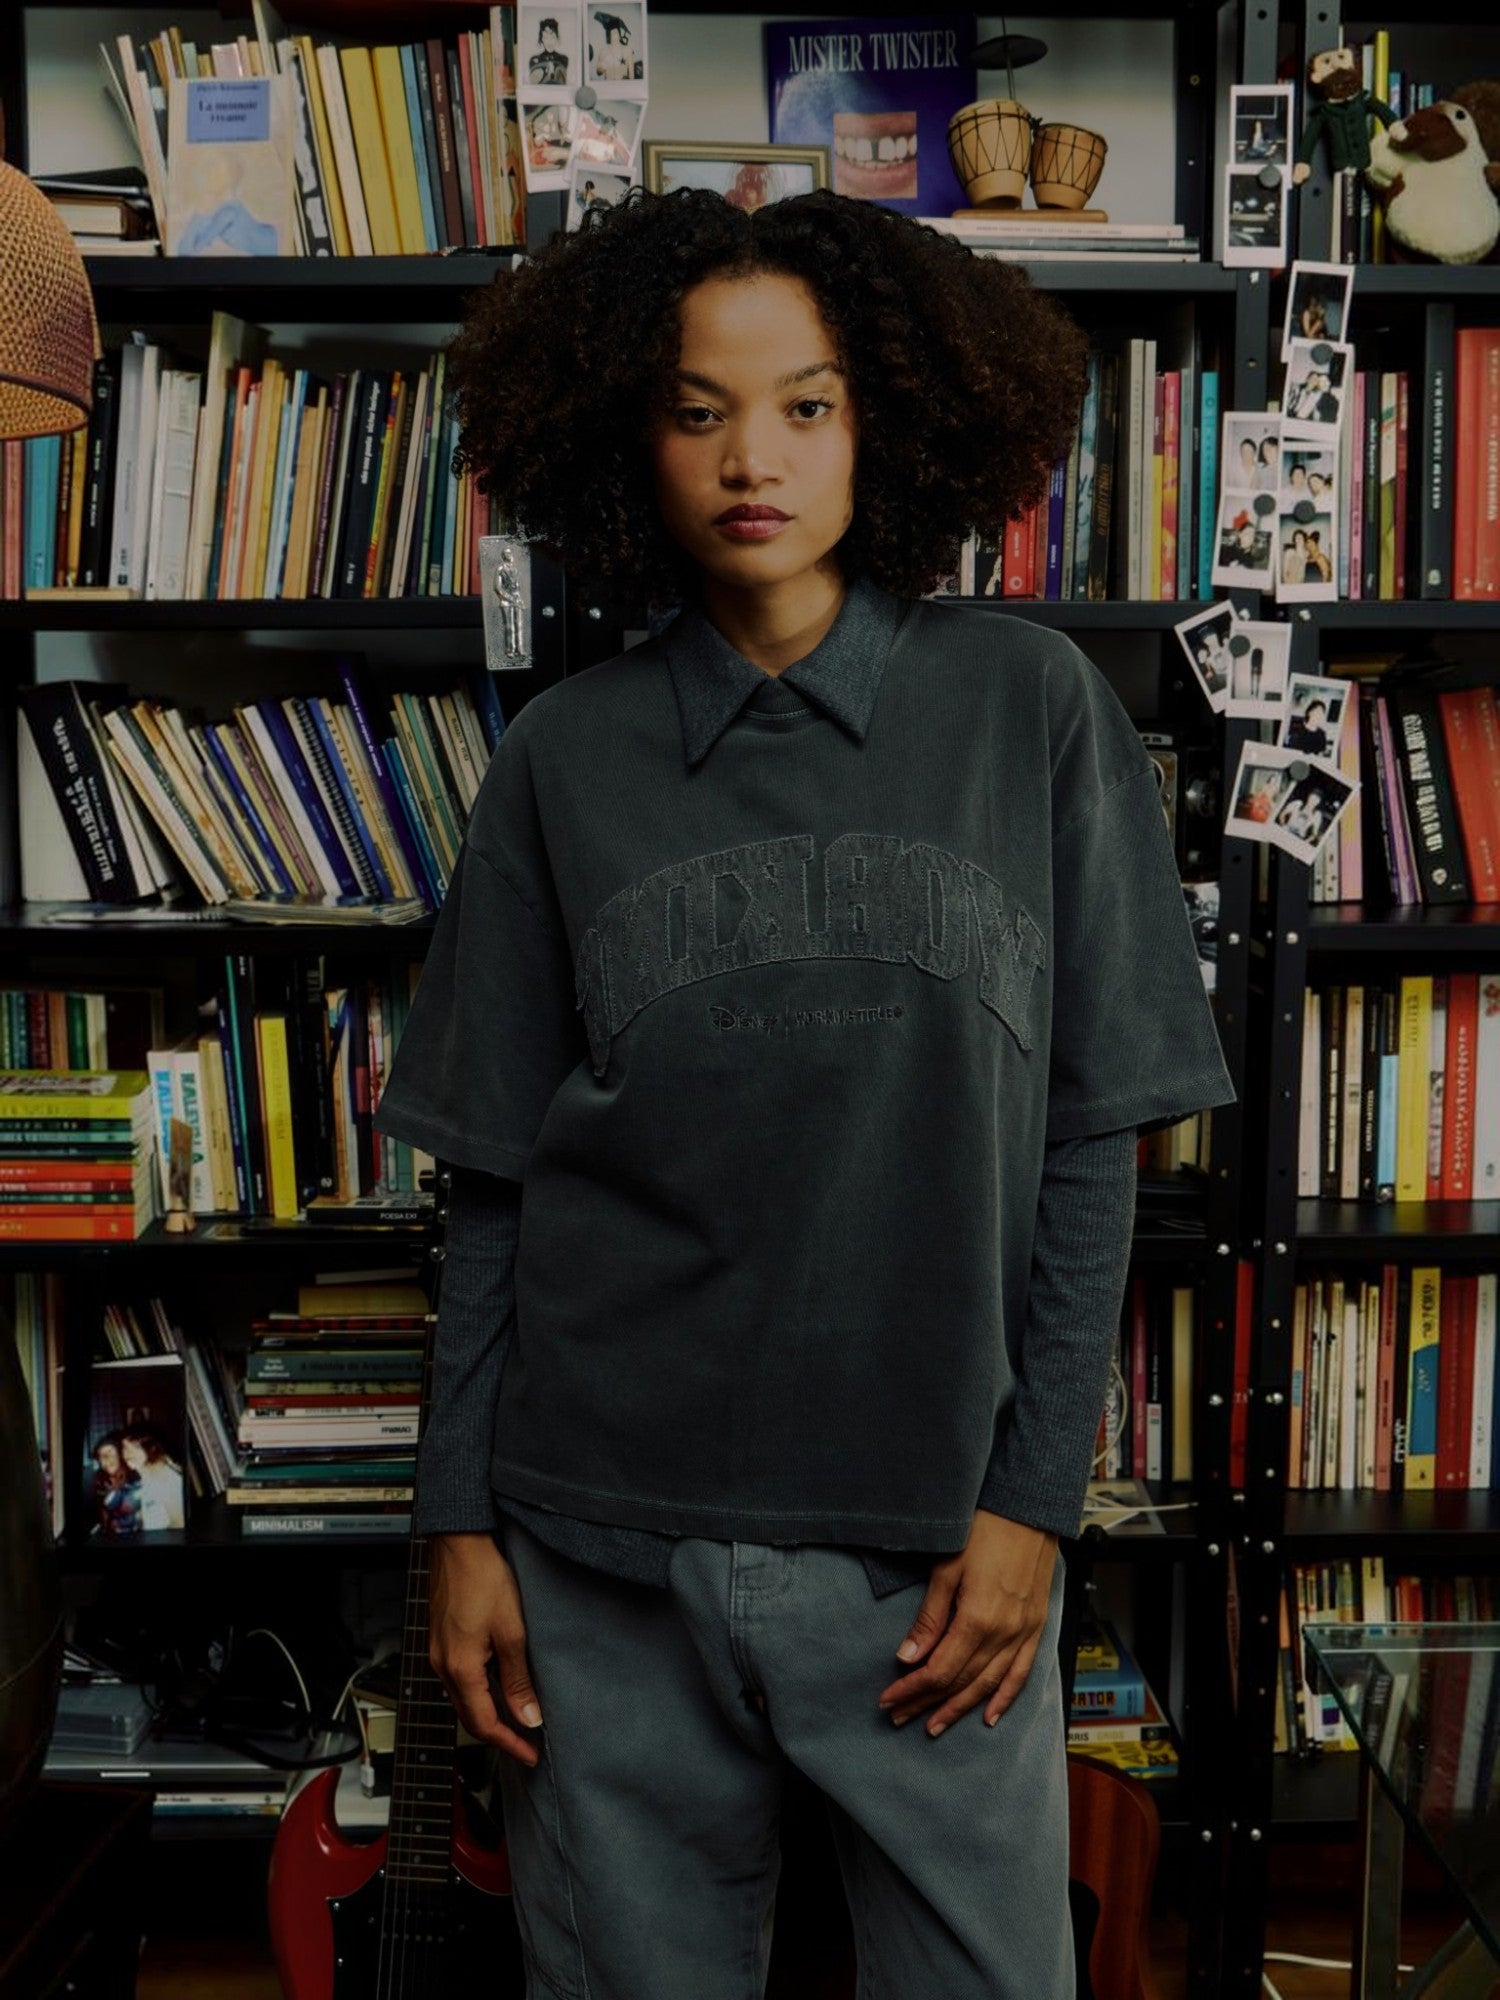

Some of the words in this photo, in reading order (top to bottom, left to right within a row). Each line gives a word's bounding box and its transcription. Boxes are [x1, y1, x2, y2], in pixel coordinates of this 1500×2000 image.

[788, 33, 865, 73] MISTER
[869, 30, 959, 72] TWISTER
[250, 1519, 324, 1532] MINIMALISM
